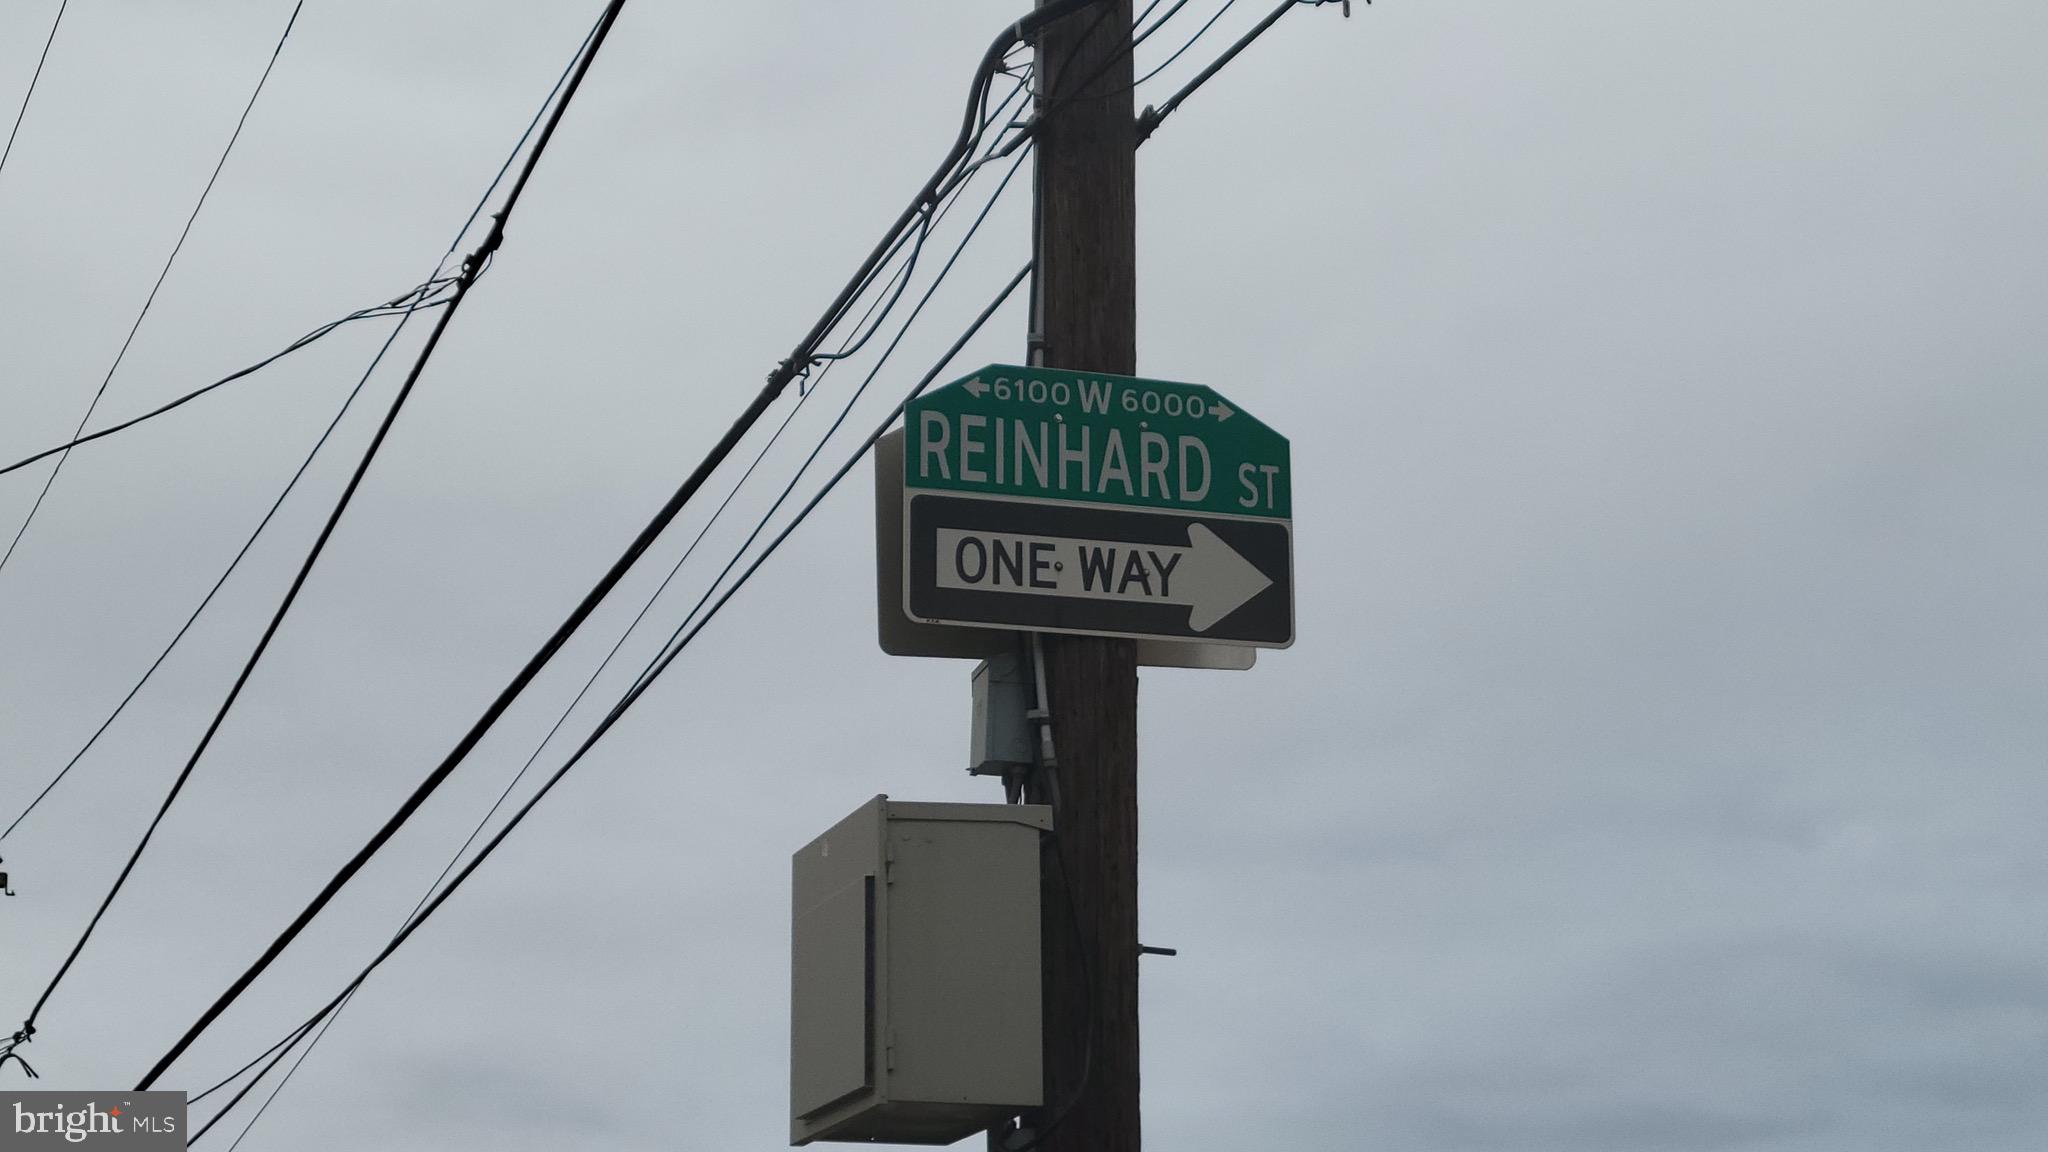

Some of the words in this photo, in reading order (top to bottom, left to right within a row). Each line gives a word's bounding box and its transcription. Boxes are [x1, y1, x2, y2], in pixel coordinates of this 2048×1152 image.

[994, 378, 1070, 406] 6100
[1077, 379, 1113, 415] W
[1121, 389, 1206, 419] 6000
[919, 409, 1212, 501] REINHARD
[1238, 463, 1280, 509] ST
[955, 537, 1057, 589] ONE
[1078, 546, 1182, 597] WAY
